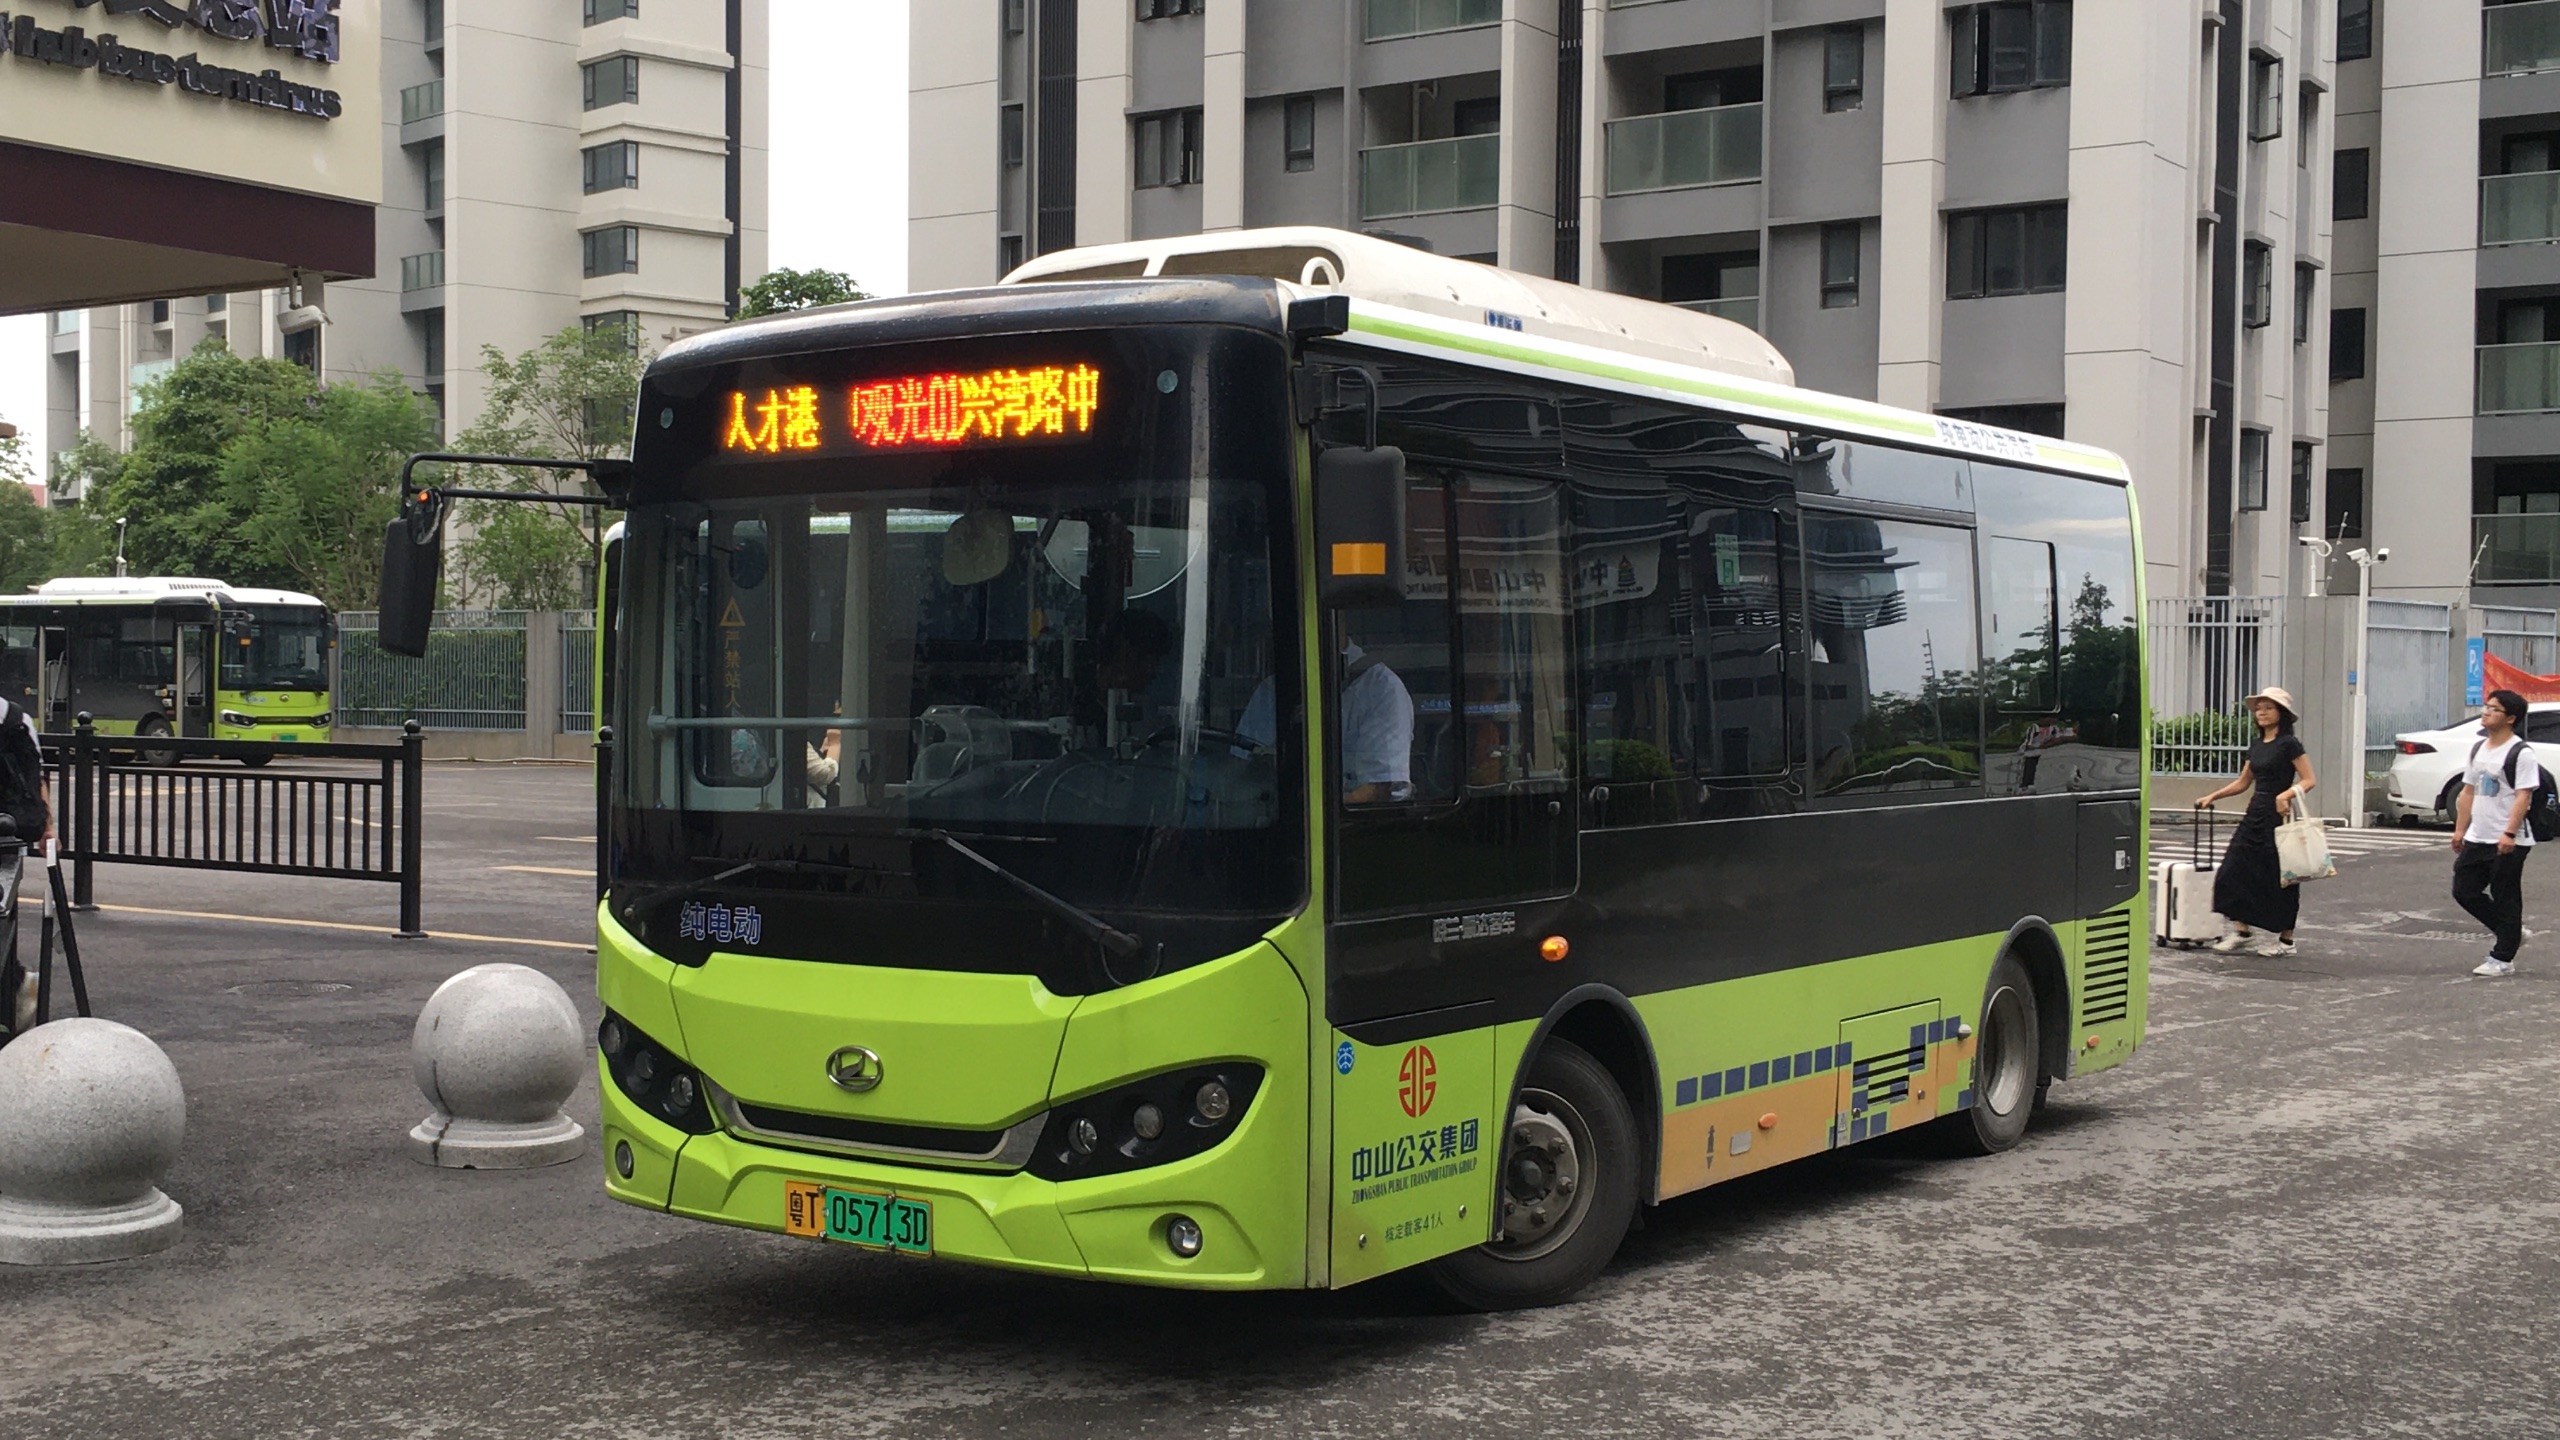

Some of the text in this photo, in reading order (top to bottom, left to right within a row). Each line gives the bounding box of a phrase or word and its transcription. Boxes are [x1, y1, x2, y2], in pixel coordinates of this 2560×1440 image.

[97, 33, 176, 84] bus
[176, 52, 342, 120] terminus
[727, 385, 821, 453] 人才港
[680, 900, 761, 945] 纯电动
[1352, 1118, 1479, 1182] 中山公交集团
[1388, 1175, 1409, 1194] PUBLIC
[1458, 1156, 1478, 1175] GROUP
